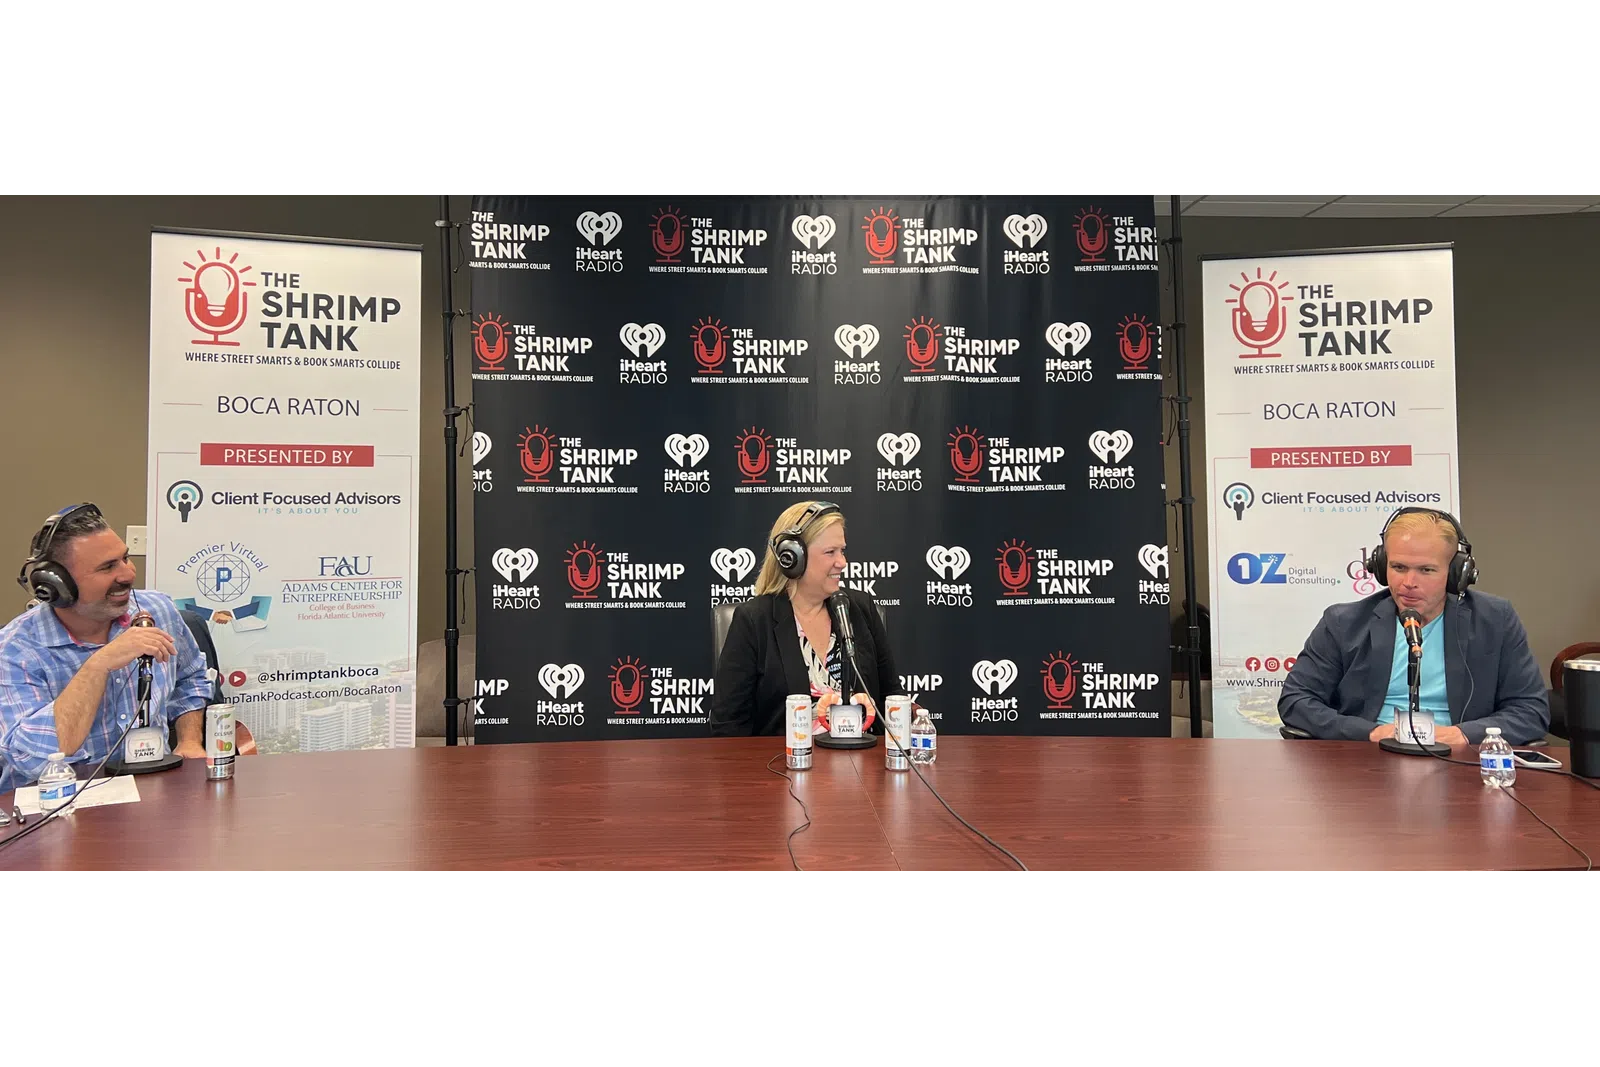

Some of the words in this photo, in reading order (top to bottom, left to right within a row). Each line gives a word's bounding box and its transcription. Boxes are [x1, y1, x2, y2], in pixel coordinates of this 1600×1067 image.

[472, 211, 494, 222] THE
[691, 218, 712, 228] THE
[903, 218, 924, 228] THE
[1113, 217, 1134, 226] THE
[471, 222, 550, 241] SHRIMP
[691, 229, 768, 247] SHRIMP
[903, 228, 978, 246] SHRIMP
[471, 241, 527, 260] TANK
[576, 247, 622, 261] iHeart
[691, 248, 744, 264] TANK
[792, 250, 837, 263] iHeart
[903, 246, 956, 264] TANK
[1004, 250, 1049, 263] iHeart
[576, 261, 623, 273] RADIO
[792, 264, 837, 275] RADIO
[1004, 263, 1050, 275] RADIO
[261, 272, 300, 288] THE
[1298, 285, 1334, 299] THE
[262, 291, 401, 323] SHRIMP
[1299, 298, 1433, 328] SHRIMP
[260, 322, 358, 352] TANK
[513, 325, 535, 335] THE
[732, 329, 753, 338] THE
[944, 327, 965, 337] THE
[514, 336, 593, 354] SHRIMP
[732, 340, 808, 356] SHRIMP
[945, 337, 1020, 356] SHRIMP
[1299, 329, 1392, 357] TANK
[185, 352, 219, 363] WHERE
[221, 354, 254, 364] STREET
[256, 355, 292, 366] SMARTS
[294, 357, 301, 366] &
[304, 358, 328, 367] BOOK
[330, 359, 365, 369] SMARTS
[367, 360, 401, 370] COLLIDE
[514, 355, 570, 372] TANK
[620, 359, 667, 373] iHeart
[732, 358, 786, 374] TANK
[835, 360, 880, 373] iHeart
[945, 355, 997, 374] TANK
[1046, 358, 1092, 371] iHeart
[1234, 365, 1264, 374] WHERE
[1265, 364, 1294, 373] STREET
[1296, 363, 1329, 372] SMARTS
[1331, 363, 1337, 372] &
[1340, 362, 1363, 372] BOOK
[1365, 361, 1399, 371] SMARTS
[1401, 360, 1435, 369] COLLIDE
[620, 373, 668, 385] RADIO
[835, 373, 881, 385] RADIO
[1046, 371, 1093, 383] RADIO
[217, 396, 281, 415] BOCA
[288, 398, 360, 417] RATON
[1264, 403, 1320, 420] BOCA
[1327, 401, 1396, 418] RATON
[560, 437, 581, 447] THE
[776, 438, 796, 447] THE
[988, 438, 1010, 447] THE
[224, 449, 326, 464] PRESENTED
[332, 451, 353, 464] BY
[560, 449, 638, 465] SHRIMP
[776, 449, 852, 465] SHRIMP
[989, 447, 1065, 465] SHRIMP
[1272, 451, 1365, 466] PRESENTED
[1371, 450, 1391, 464] BY
[560, 467, 614, 484] TANK
[665, 469, 709, 481] iHeart
[776, 467, 829, 483] TANK
[877, 468, 922, 480] iHeart
[989, 466, 1042, 482] TANK
[1089, 466, 1134, 478] iHeart
[665, 482, 710, 493] RADIO
[877, 480, 922, 492] RADIO
[1090, 478, 1135, 489] RADIO
[212, 492, 259, 505] Client
[263, 492, 331, 505] Focused
[335, 492, 401, 505] Advisors
[1262, 492, 1303, 505] Client
[1307, 491, 1371, 504] Focused
[1375, 490, 1441, 503] Advisors
[177, 543, 225, 575] Premier
[231, 542, 269, 573] Virtual
[607, 553, 628, 563] THE
[1037, 550, 1058, 559] THE
[607, 564, 685, 580] SHRIMP
[1038, 559, 1114, 577] SHRIMP
[1289, 567, 1317, 576] Digital
[216, 567, 232, 592] P
[1037, 578, 1091, 595] TANK
[282, 583, 328, 593] ADAMS
[331, 581, 378, 591] CENTER
[381, 581, 402, 590] FOR
[493, 584, 540, 597] iHeart
[607, 582, 662, 599] TANK
[711, 584, 756, 597] iHeart
[927, 581, 972, 596] iHeart
[282, 591, 402, 603] ENTREPRENEURSHIP
[493, 598, 541, 610] RADIO
[927, 595, 973, 607] RADIO
[309, 604, 336, 613] College
[338, 603, 345, 611] of
[346, 603, 375, 611] Business
[351, 611, 386, 620] University
[258, 666, 379, 684] @shrimptankboca
[651, 668, 672, 677] THE
[1082, 663, 1103, 673] THE
[651, 678, 714, 696] SHRIM
[1082, 673, 1159, 691] SHRIMP
[537, 700, 584, 714] iHeart
[650, 697, 704, 714] TANK
[972, 697, 1018, 710] iHeart
[1082, 692, 1135, 709] TANK
[537, 714, 585, 726] RADIO
[972, 710, 1019, 722] RADIO
